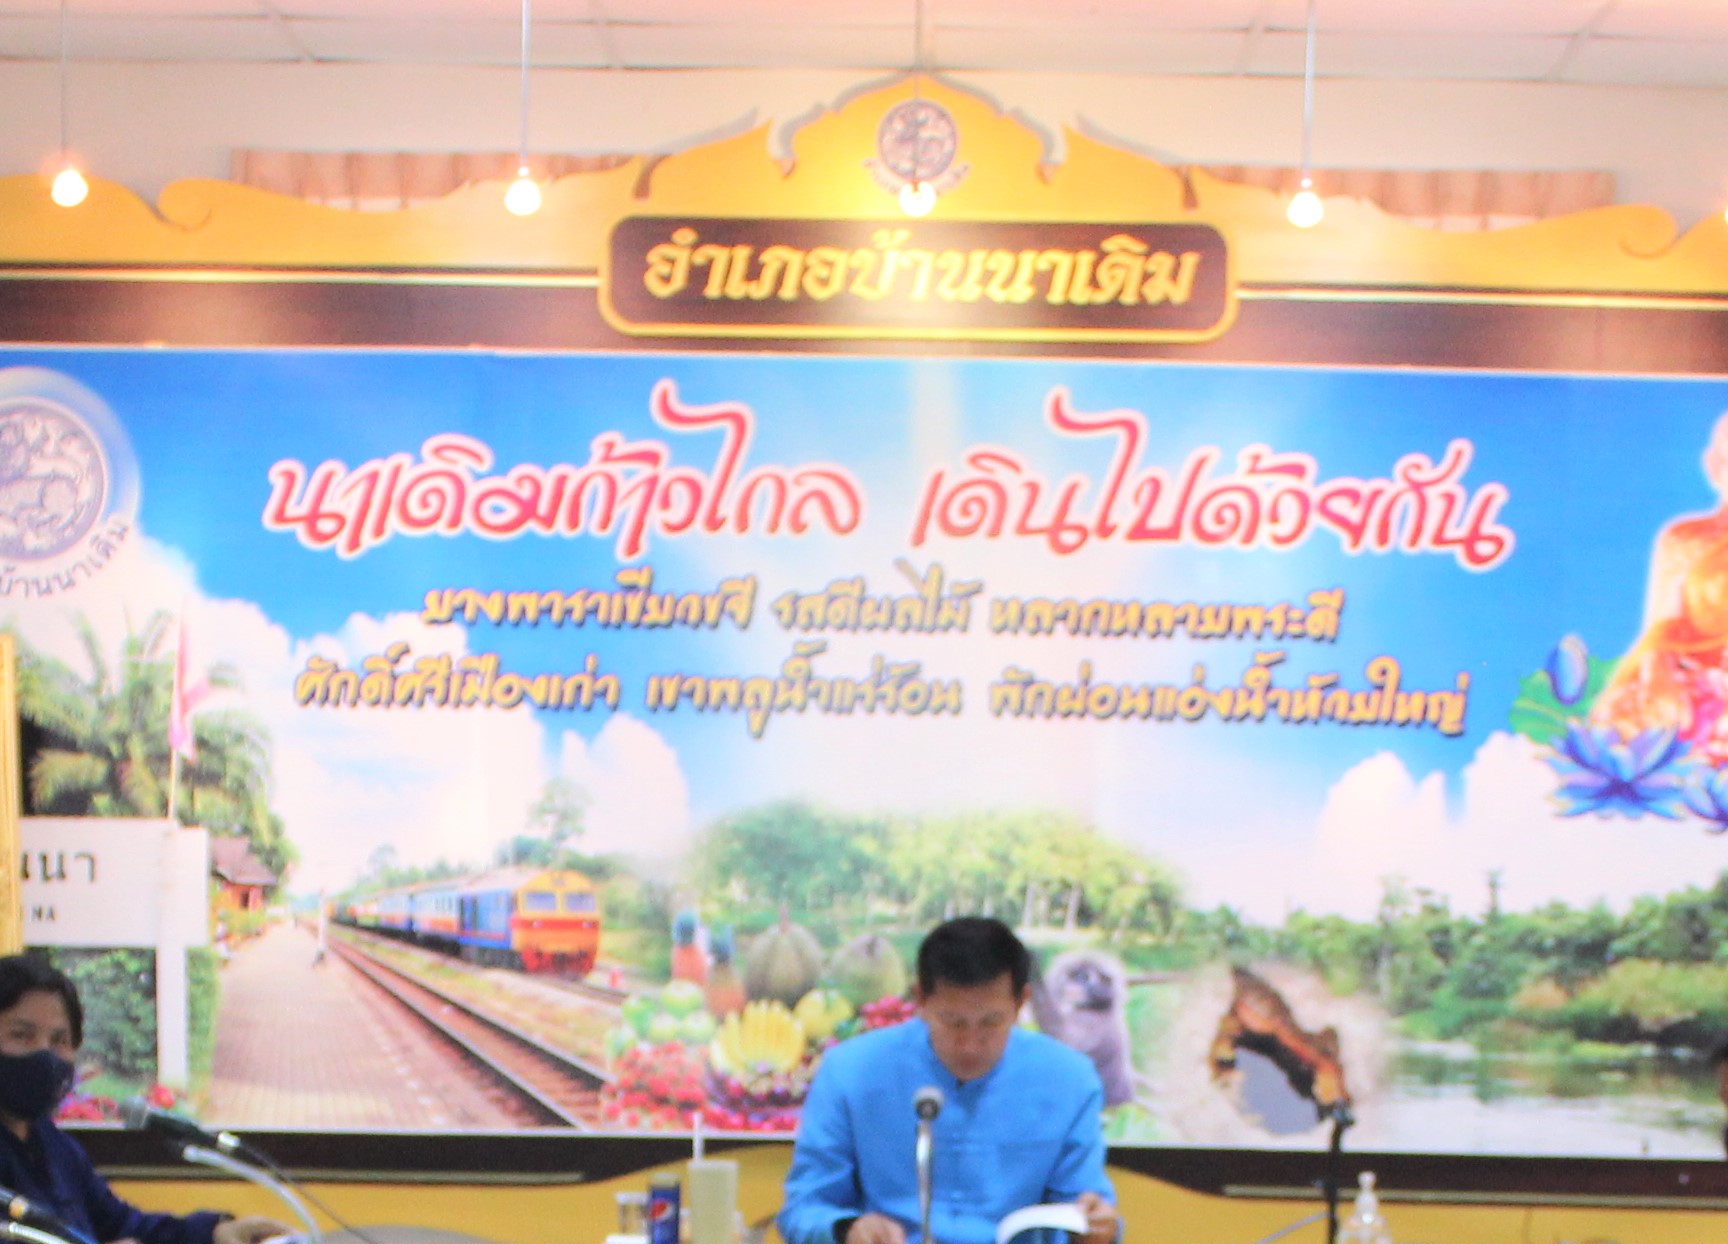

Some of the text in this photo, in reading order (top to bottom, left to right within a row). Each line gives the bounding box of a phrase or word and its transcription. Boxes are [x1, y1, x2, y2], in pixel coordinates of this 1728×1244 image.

[643, 226, 1200, 306] อำเภอบ้านนาเดิม
[264, 378, 1514, 572] นาเดิมก้าวไกล เดินไปด้วยกัน
